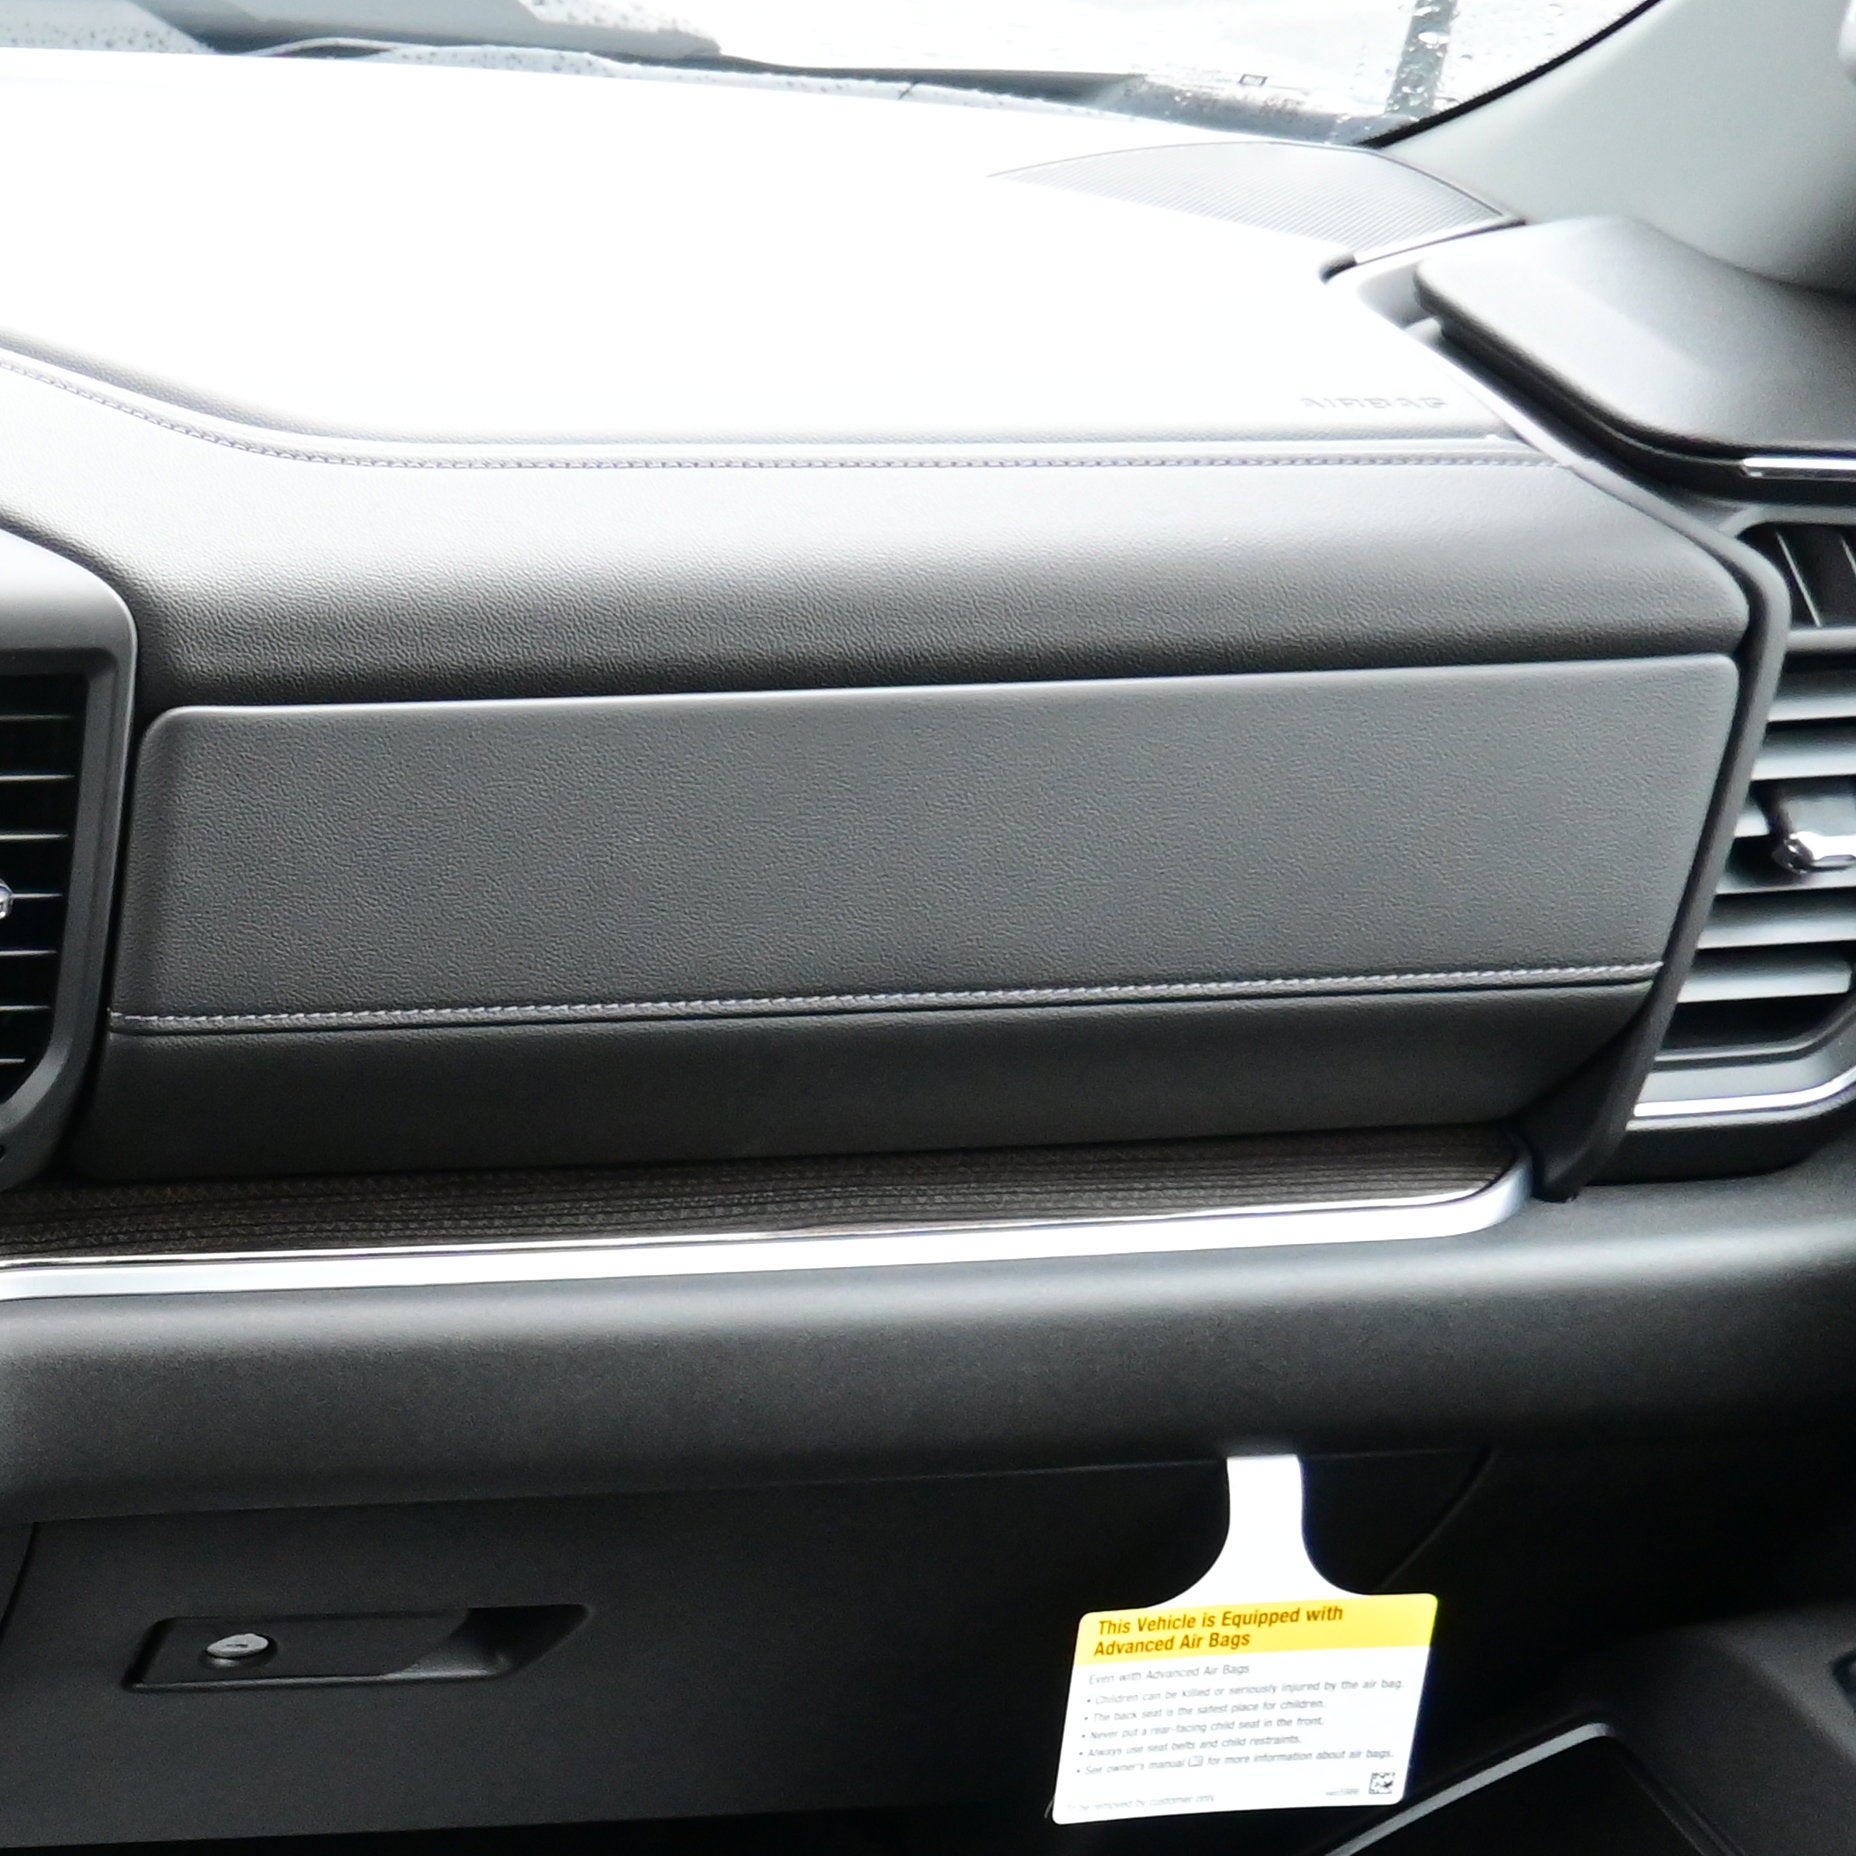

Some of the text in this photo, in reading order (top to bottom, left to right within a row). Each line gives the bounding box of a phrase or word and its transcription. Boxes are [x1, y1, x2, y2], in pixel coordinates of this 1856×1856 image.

[1299, 396, 1448, 409] AIRBAG
[1098, 1606, 1343, 1636] This Vehicle is Equipped with
[1093, 1631, 1251, 1658] Advanced Air Bags
[1089, 1664, 1250, 1684] Even with Advanced Air Bags
[1096, 1694, 1138, 1704] Children
[1142, 1693, 1161, 1701] can
[1165, 1691, 1177, 1699] be
[1229, 1684, 1277, 1694] seriously
[1281, 1682, 1320, 1693] injured
[1324, 1681, 1337, 1691] by
[1341, 1681, 1358, 1689] the
[1363, 1680, 1376, 1689] air
[1093, 1713, 1110, 1721] The
[1141, 1709, 1162, 1718] seat
[1178, 1707, 1193, 1715] the
[1231, 1702, 1258, 1713] place
[1263, 1702, 1276, 1710] for
[1122, 1729, 1138, 1738] put
[1210, 1721, 1235, 1731] child
[1238, 1720, 1260, 1728] seat
